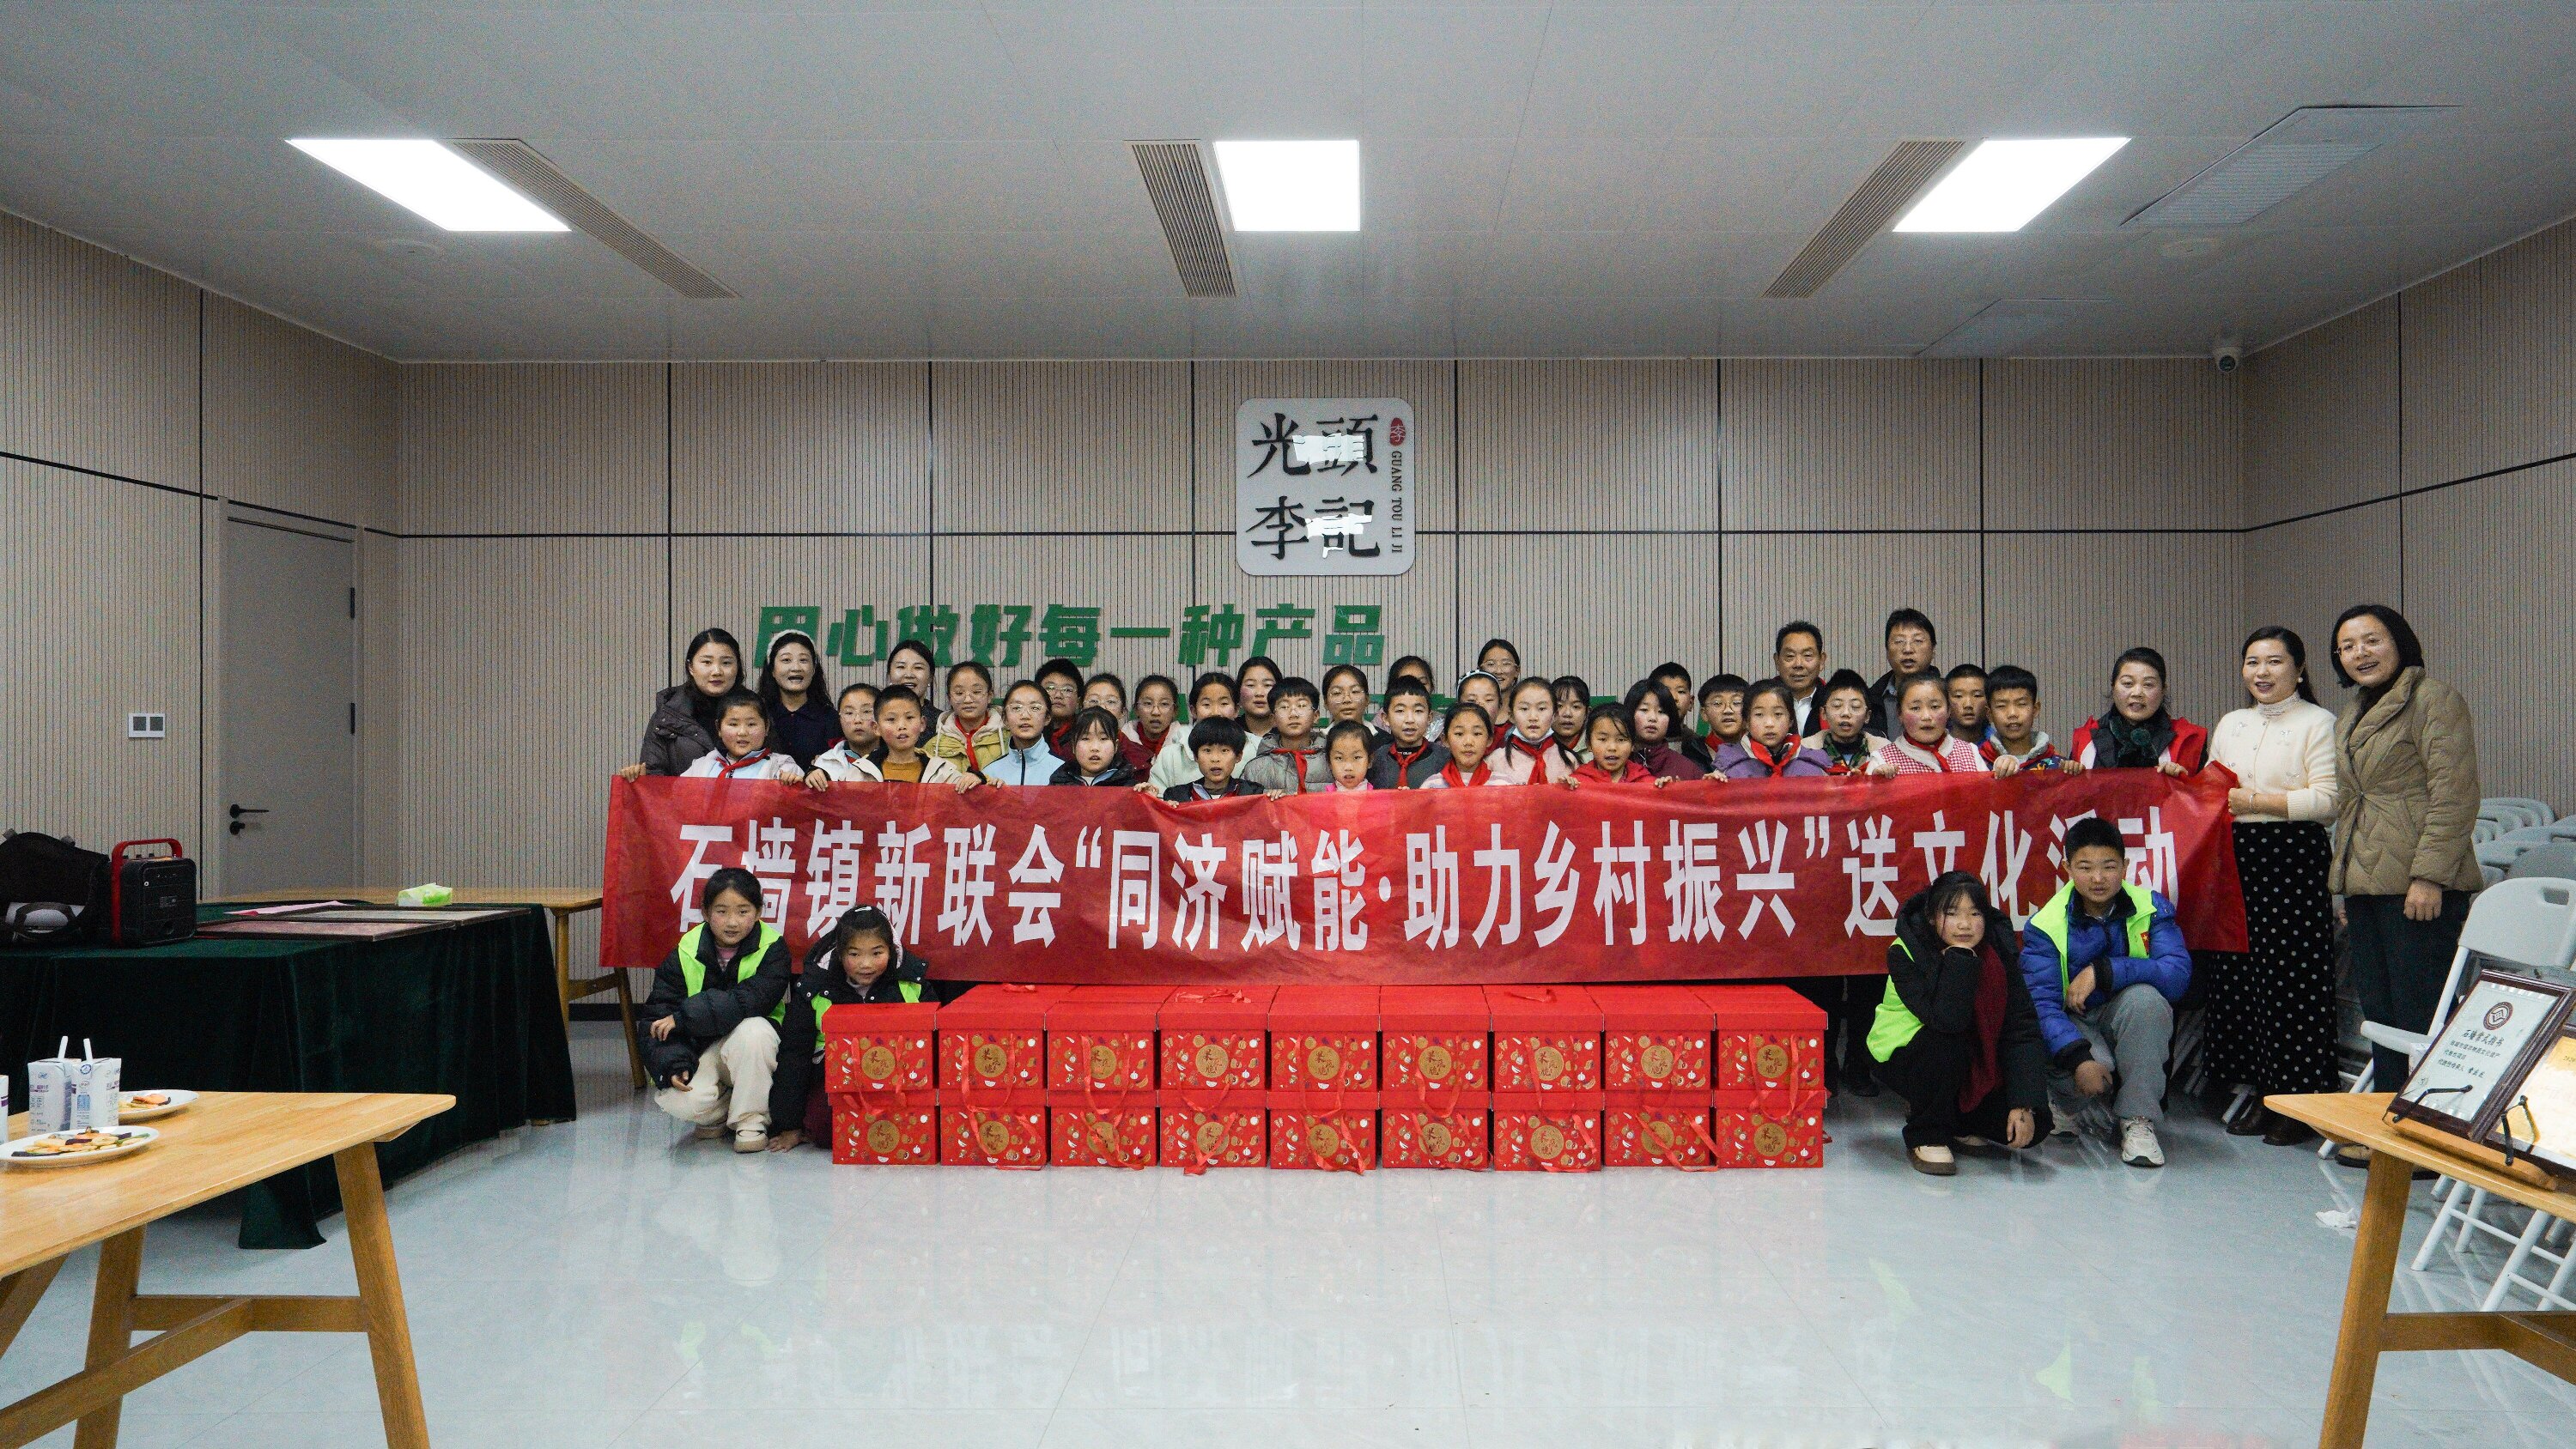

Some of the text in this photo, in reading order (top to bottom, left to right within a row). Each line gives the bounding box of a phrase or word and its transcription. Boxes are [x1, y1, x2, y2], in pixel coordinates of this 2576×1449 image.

[1391, 451, 1403, 554] GUANG TOU LI JI
